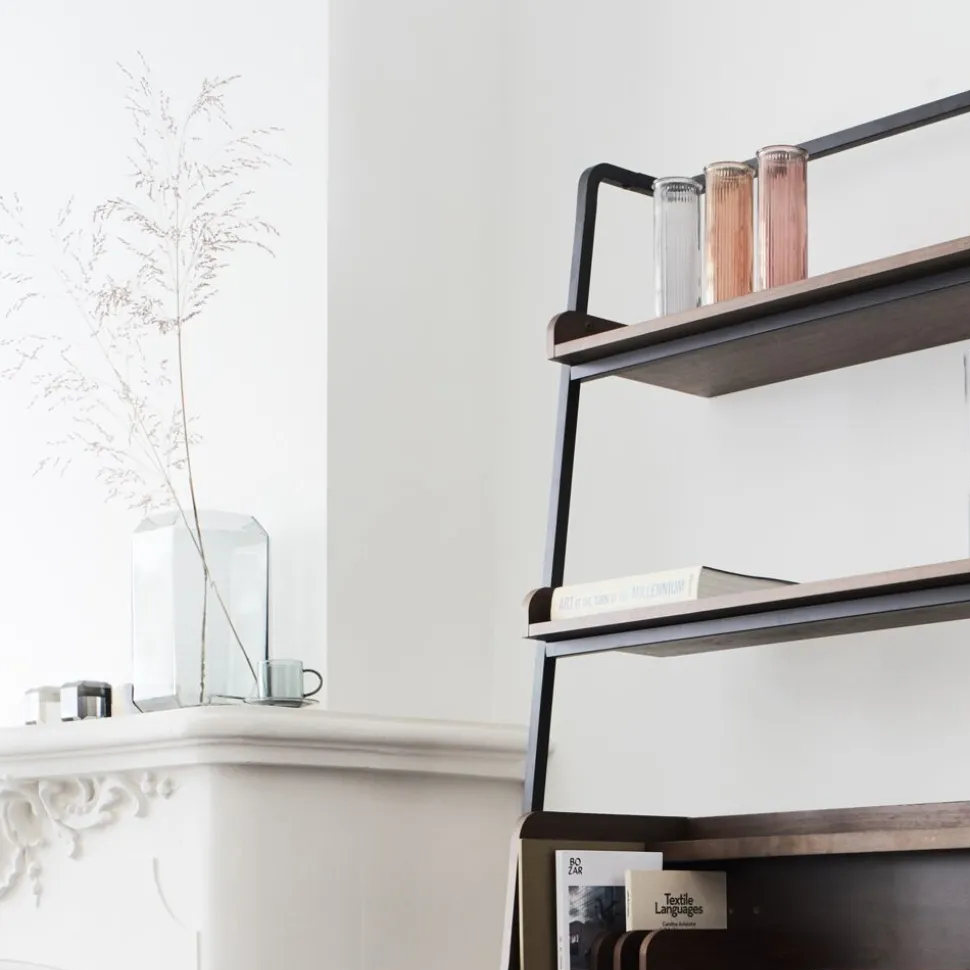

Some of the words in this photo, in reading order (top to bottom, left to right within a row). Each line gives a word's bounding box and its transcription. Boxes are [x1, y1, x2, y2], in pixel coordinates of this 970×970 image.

[558, 596, 574, 611] ART
[631, 577, 686, 600] MILLENNIUM
[569, 858, 581, 867] BO
[568, 866, 582, 875] ZAR
[664, 893, 693, 905] Textile
[654, 902, 704, 918] Languages
